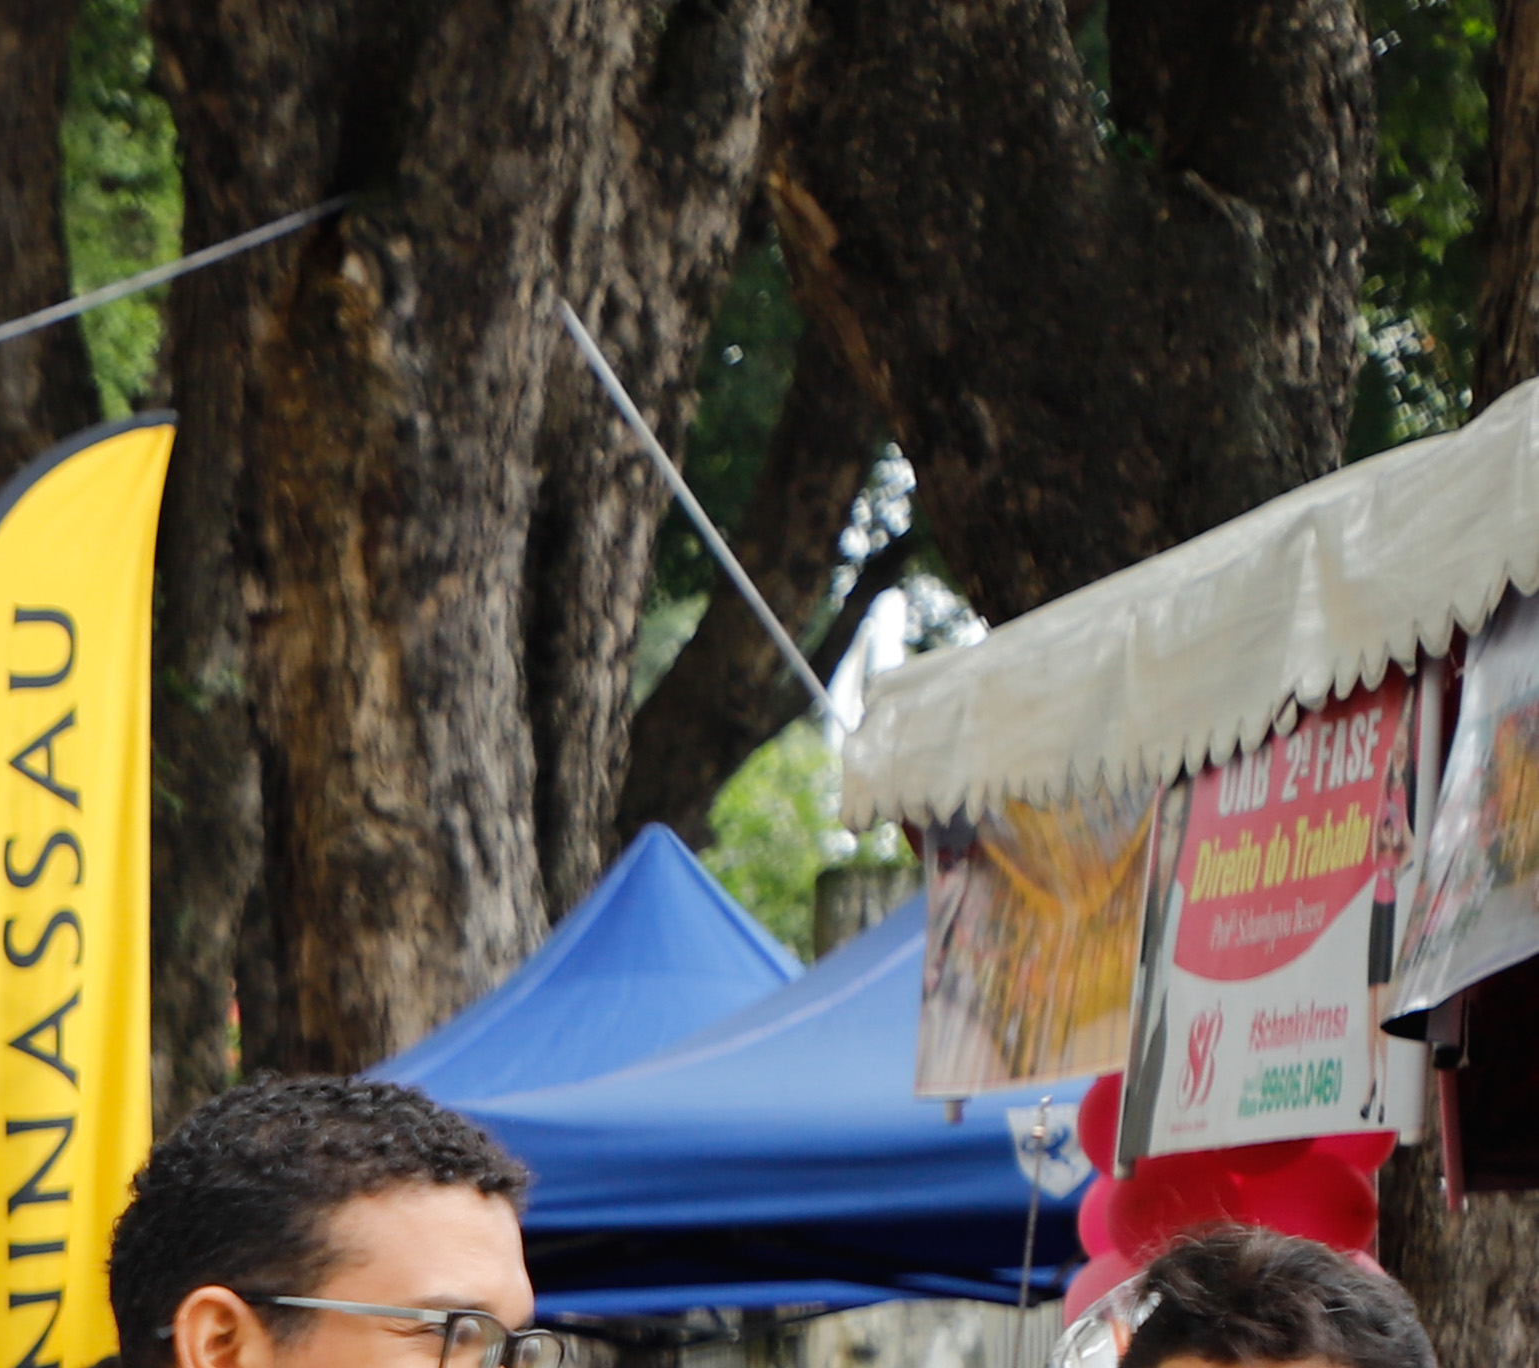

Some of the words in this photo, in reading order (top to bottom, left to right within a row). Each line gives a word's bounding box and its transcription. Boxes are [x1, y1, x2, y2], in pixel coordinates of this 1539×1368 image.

[1313, 708, 1383, 794] FASE
[1189, 831, 1262, 905] Direito
[1262, 822, 1290, 889] do
[1291, 802, 1372, 882] Trabalho
